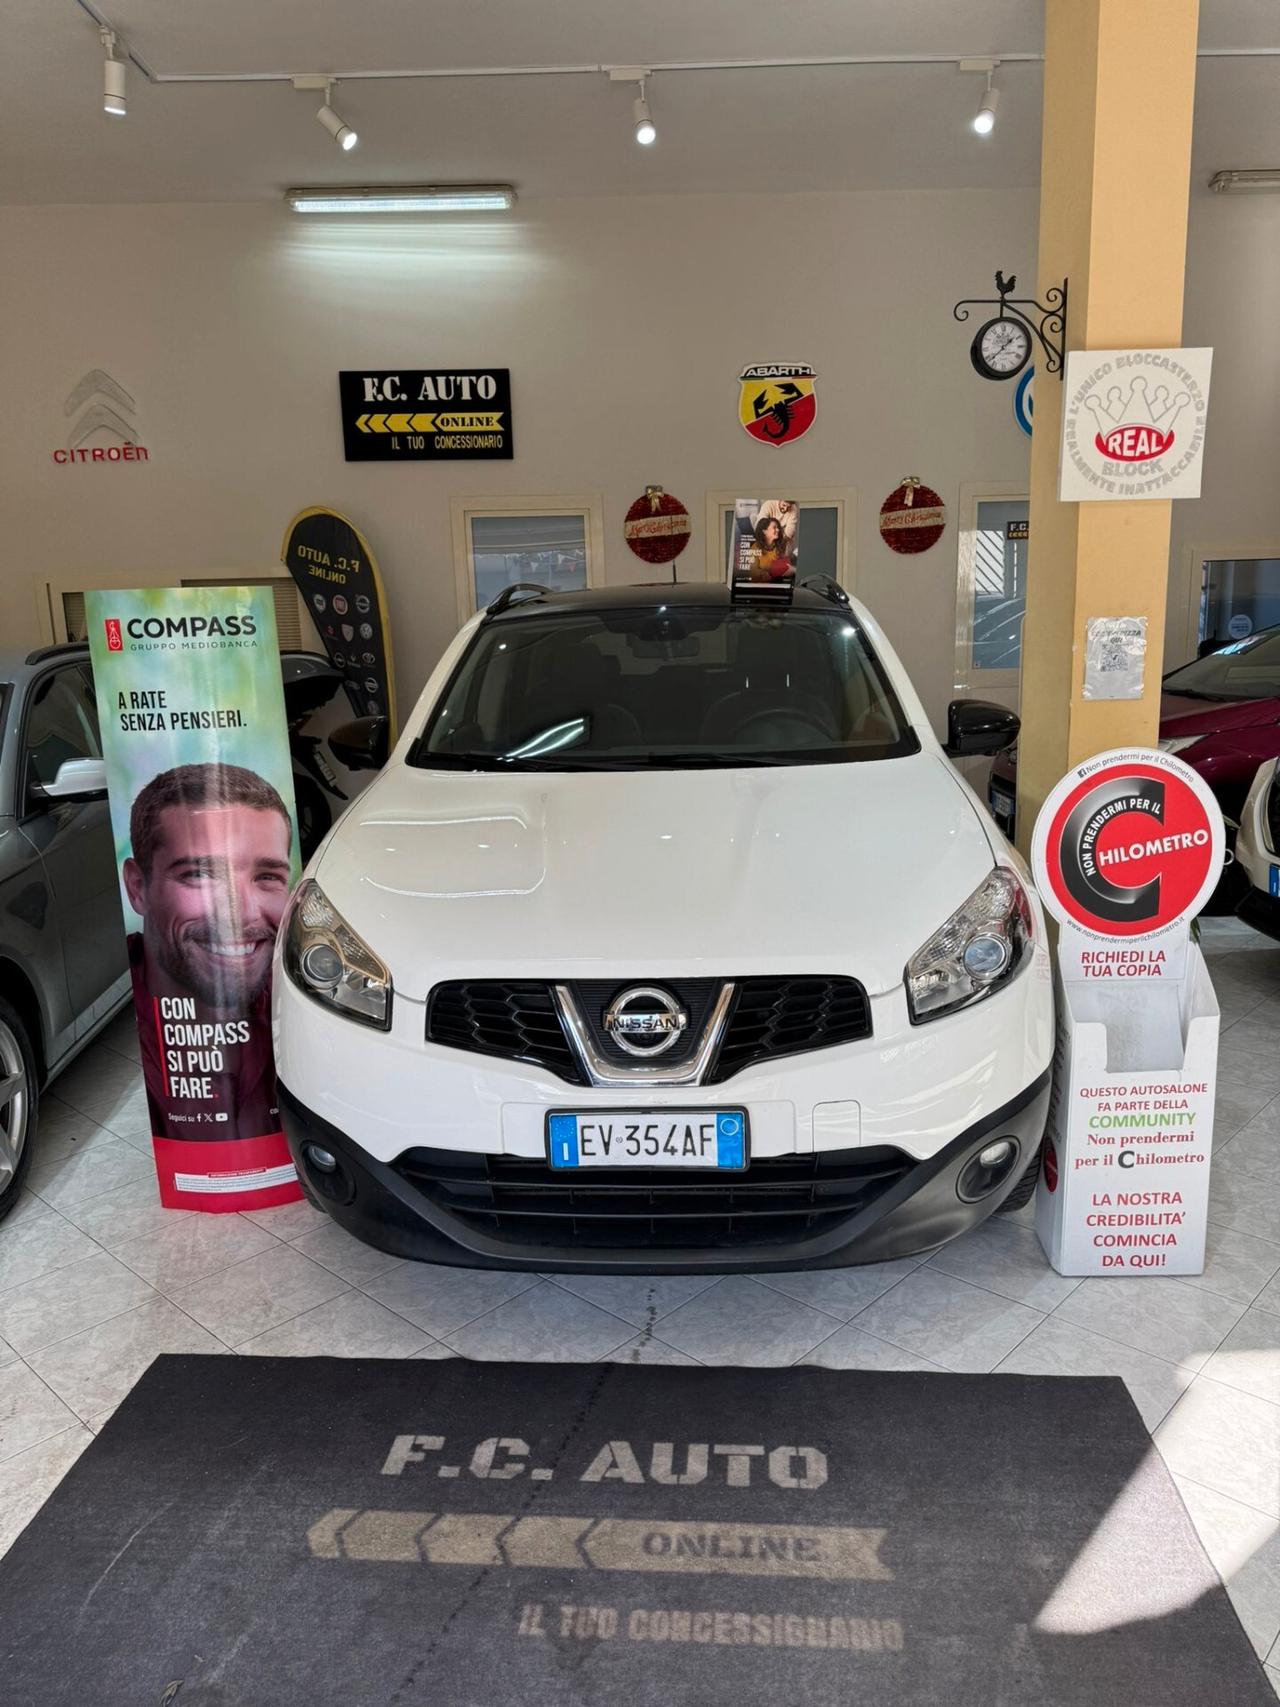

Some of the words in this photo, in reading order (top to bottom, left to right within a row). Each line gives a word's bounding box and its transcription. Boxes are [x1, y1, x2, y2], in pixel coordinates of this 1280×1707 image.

[746, 367, 810, 377] ABARTH
[363, 376, 408, 402] F.C.
[417, 375, 497, 400] AUTO
[1069, 363, 1112, 415] L'UNICO
[440, 416, 494, 428] ONLINE
[392, 437, 400, 450] IL
[407, 436, 424, 449] TUO
[434, 435, 503, 449] CONCESSIONARIO
[1108, 429, 1163, 457] REAL
[1066, 419, 1116, 493] REALMENTE
[1117, 416, 1206, 496] INATTACCABILE
[1102, 458, 1164, 478] BLOCK
[127, 616, 256, 639] COMPASS
[131, 643, 176, 651] GRUPPO
[181, 640, 257, 649] MEDIOBANCA
[119, 692, 127, 710] A
[130, 691, 167, 709] RATE
[121, 713, 167, 731] SENZA
[171, 709, 247, 730] PENSIERI.
[1086, 762, 1101, 774] Non
[1102, 753, 1140, 766] prendermi
[1160, 757, 1194, 783] Chilometro
[1130, 798, 1150, 809] PER
[1151, 802, 1161, 815] IL
[1083, 799, 1127, 850] PRENDERMI
[1081, 852, 1097, 877] NON
[1081, 951, 1144, 964] RICHIEDI
[1149, 950, 1166, 962] LA
[1083, 964, 1113, 977] TUA
[1117, 964, 1162, 977] COPIA
[161, 997, 196, 1020] CON
[612, 1016, 678, 1030] NISSAN
[164, 1020, 250, 1046] COMPASS
[167, 1050, 183, 1072] SI
[187, 1045, 224, 1073] PUÒ
[170, 1076, 219, 1099] FARE.
[1080, 1086, 1127, 1098] QUESTO
[1130, 1083, 1208, 1096] AUTOSALONE
[1098, 1102, 1111, 1112] FA
[1115, 1101, 1150, 1111] PARTE
[1154, 1099, 1188, 1109] DELLA
[1089, 1112, 1196, 1129] COMMUNITY
[1087, 1134, 1116, 1146] Non
[1120, 1131, 1195, 1148] prendermi
[1075, 1158, 1099, 1169] per
[1103, 1154, 1113, 1166] il
[1118, 1150, 1205, 1169] Chilometro
[1093, 1193, 1112, 1206] LA
[1117, 1192, 1183, 1206] NOSTRA
[1093, 1233, 1177, 1247] COMINCIA
[1102, 1255, 1125, 1267] DA
[1129, 1254, 1166, 1269] QUI!
[380, 1434, 554, 1481] F.C.
[580, 1440, 829, 1490] AUTO
[641, 1531, 821, 1563] ONLINE
[518, 1604, 545, 1638] IL
[559, 1605, 619, 1641] TUO
[627, 1608, 903, 1651] CONCESSIONARIO
